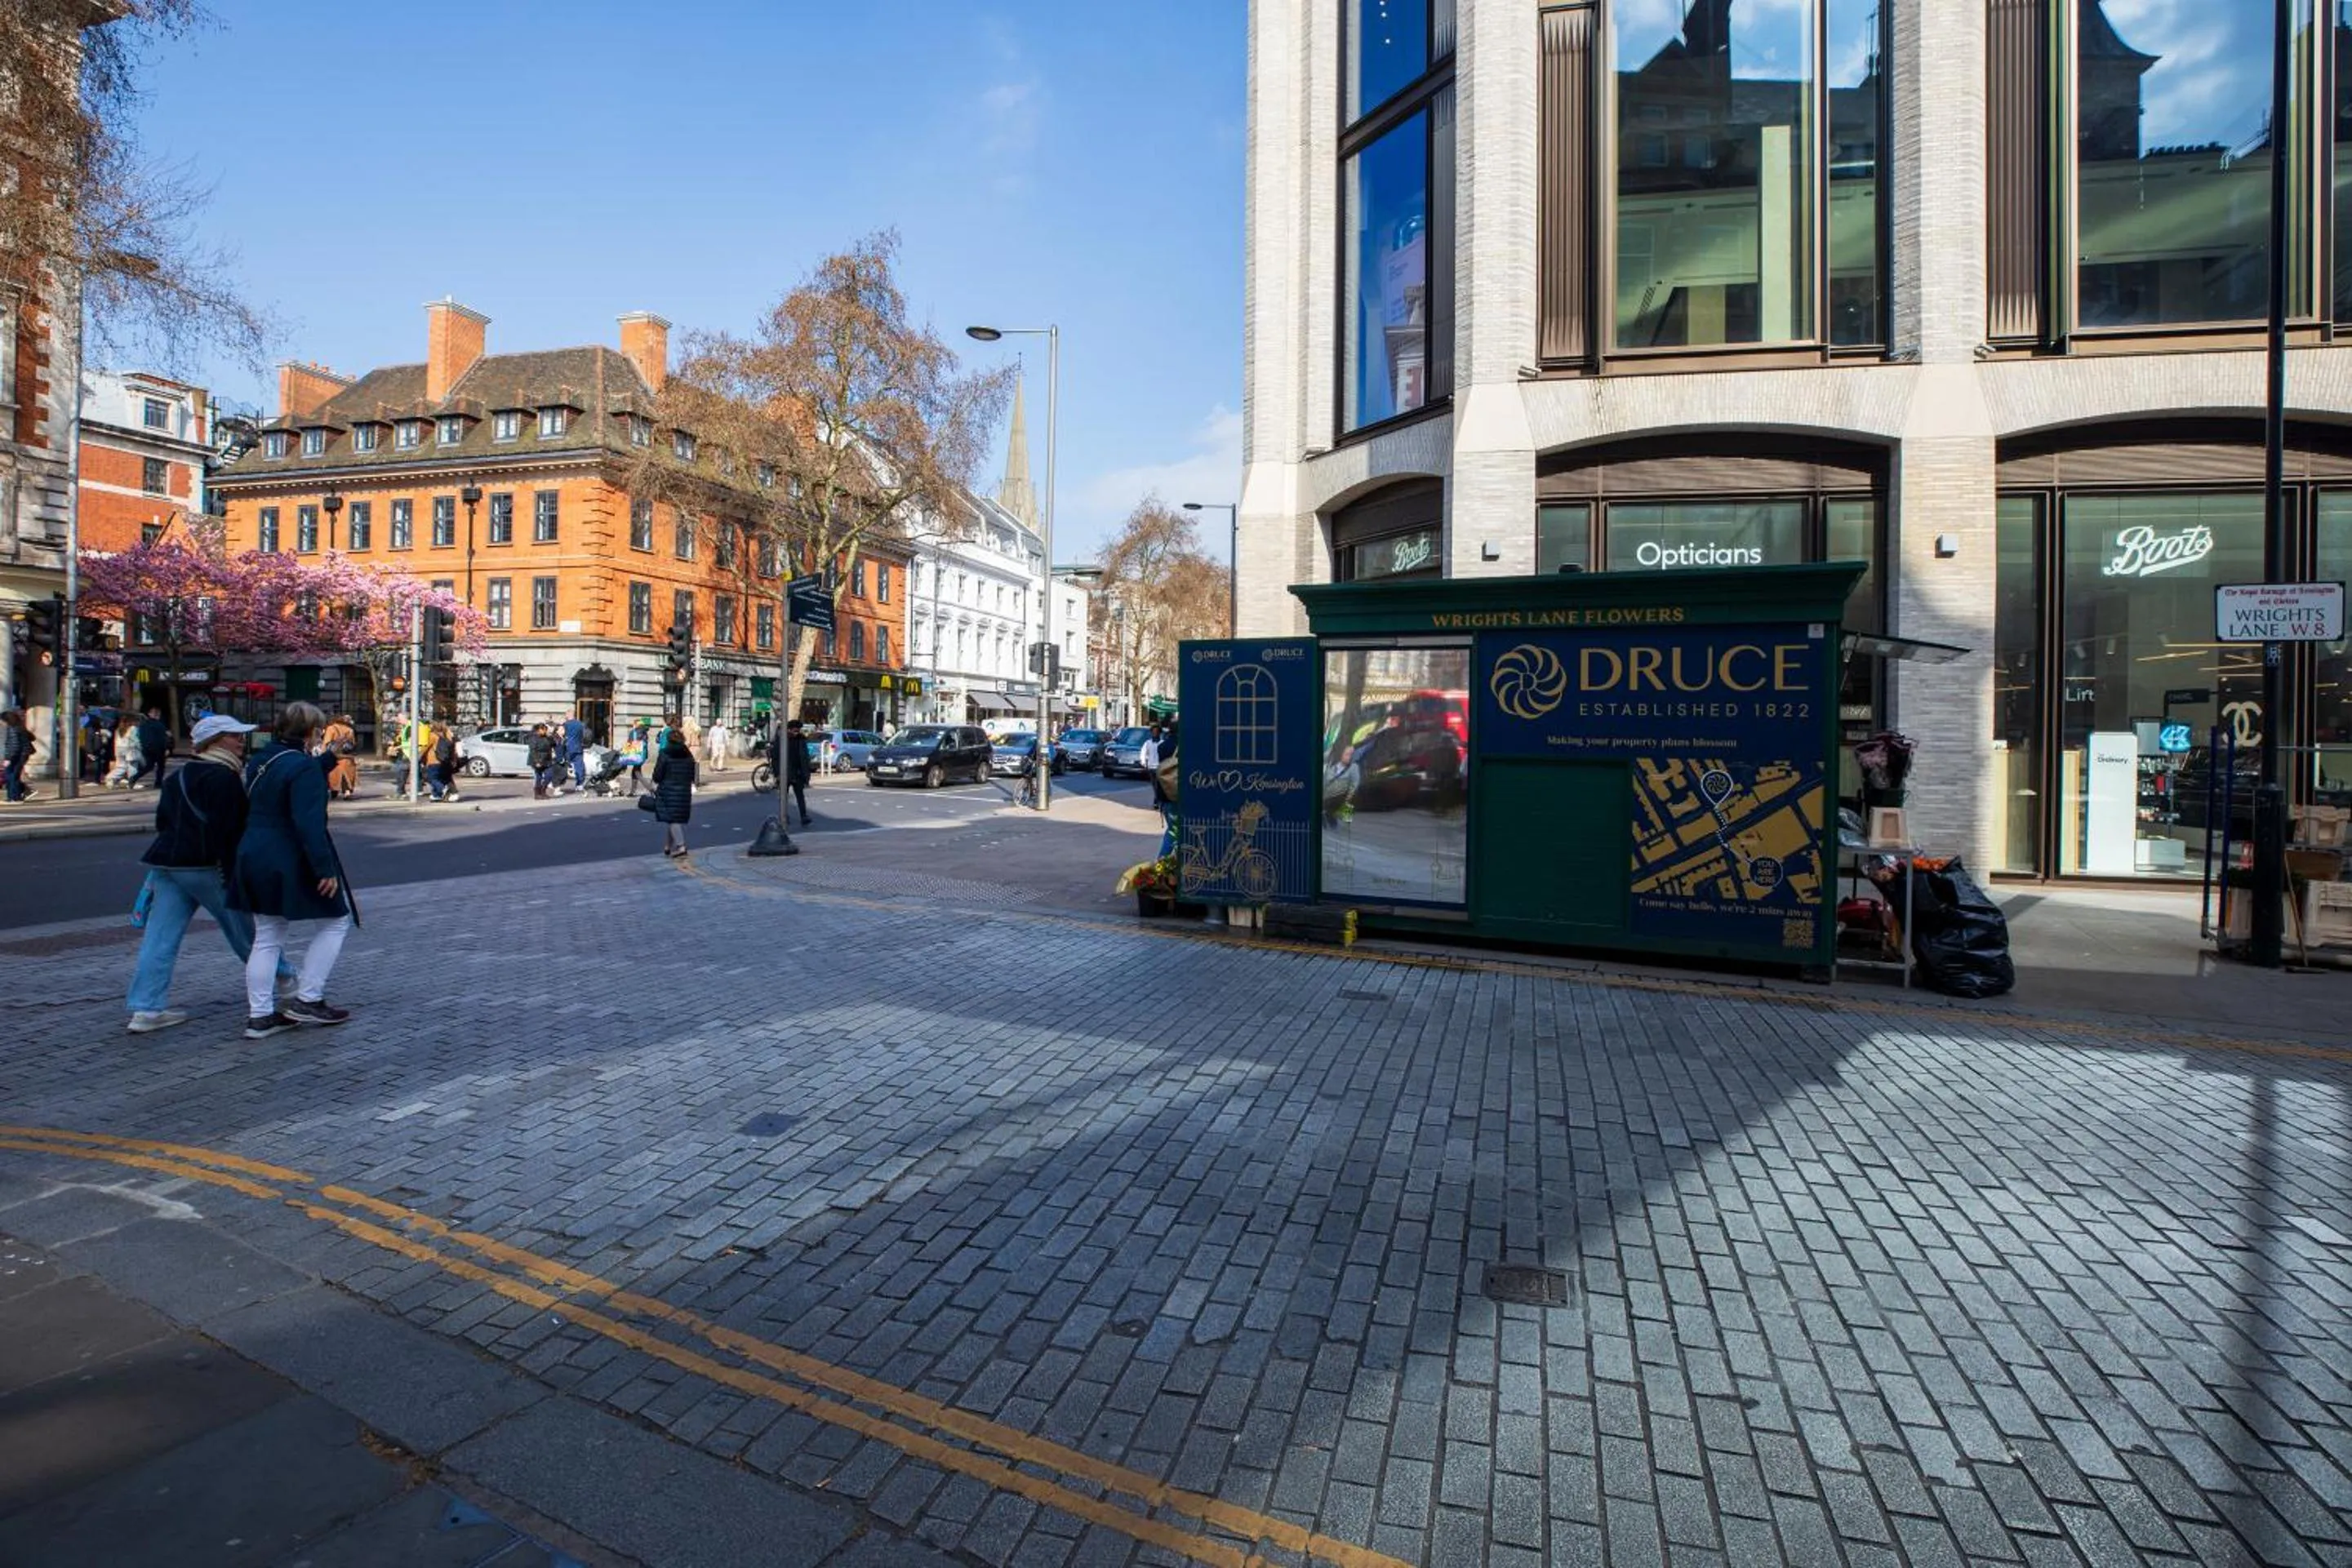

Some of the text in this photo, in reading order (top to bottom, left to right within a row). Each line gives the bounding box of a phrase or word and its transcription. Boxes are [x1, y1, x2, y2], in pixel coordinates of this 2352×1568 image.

[1391, 536, 1430, 573] Boots
[1636, 541, 1762, 570] Opticians
[2102, 524, 2214, 577] Boots
[1431, 608, 1684, 628] WRIGHTS LANE FLOWERS
[2234, 607, 2326, 622] WRIGHTS
[700, 658, 725, 670] BANK
[1579, 644, 1810, 692] DRUCE
[2065, 688, 2096, 702] Lift
[1580, 703, 1810, 718] ESTABLISHED 1822
[1585, 736, 1609, 748] your
[1612, 736, 1657, 748] property
[1692, 737, 1737, 748] blossom
